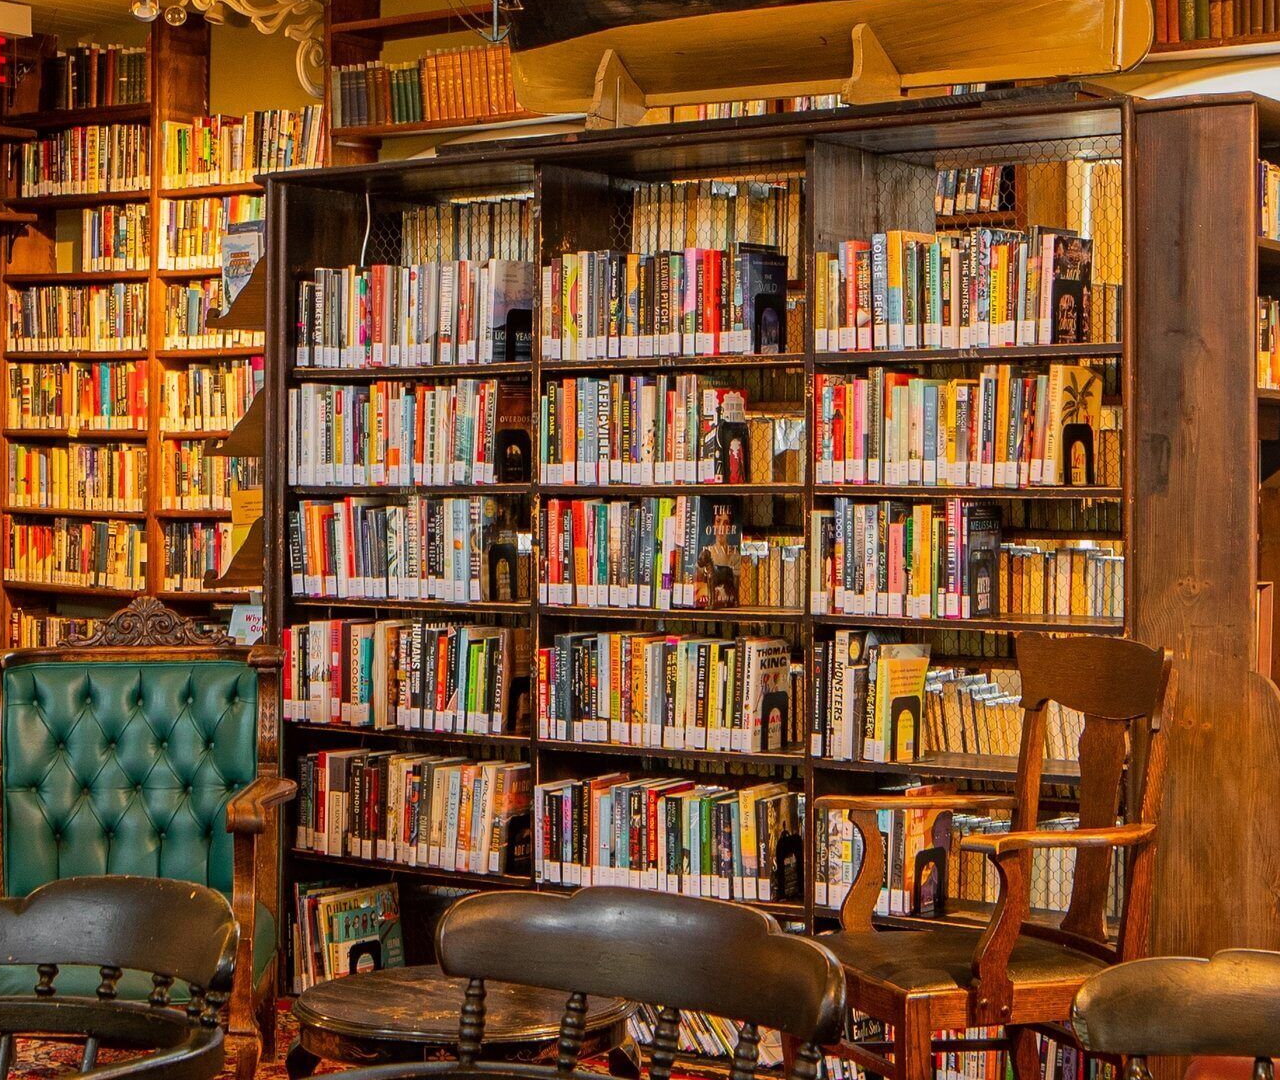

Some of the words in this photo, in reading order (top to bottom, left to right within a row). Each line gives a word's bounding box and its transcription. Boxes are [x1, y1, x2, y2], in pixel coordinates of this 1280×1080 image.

[660, 257, 669, 291] ELEVATOR
[873, 238, 884, 278] LOUISE
[660, 292, 669, 323] PITCH
[873, 294, 884, 326] PENN
[598, 383, 608, 460] AFRICVILLE
[835, 553, 843, 580] EARTH
[866, 547, 875, 568] ONE
[411, 624, 421, 669] HUMANS
[539, 656, 547, 680] FATE
[560, 650, 568, 680] HILARY
[760, 658, 788, 670] KING
[834, 661, 844, 721] MONSTERS
[353, 777, 361, 813] SPLENDID
